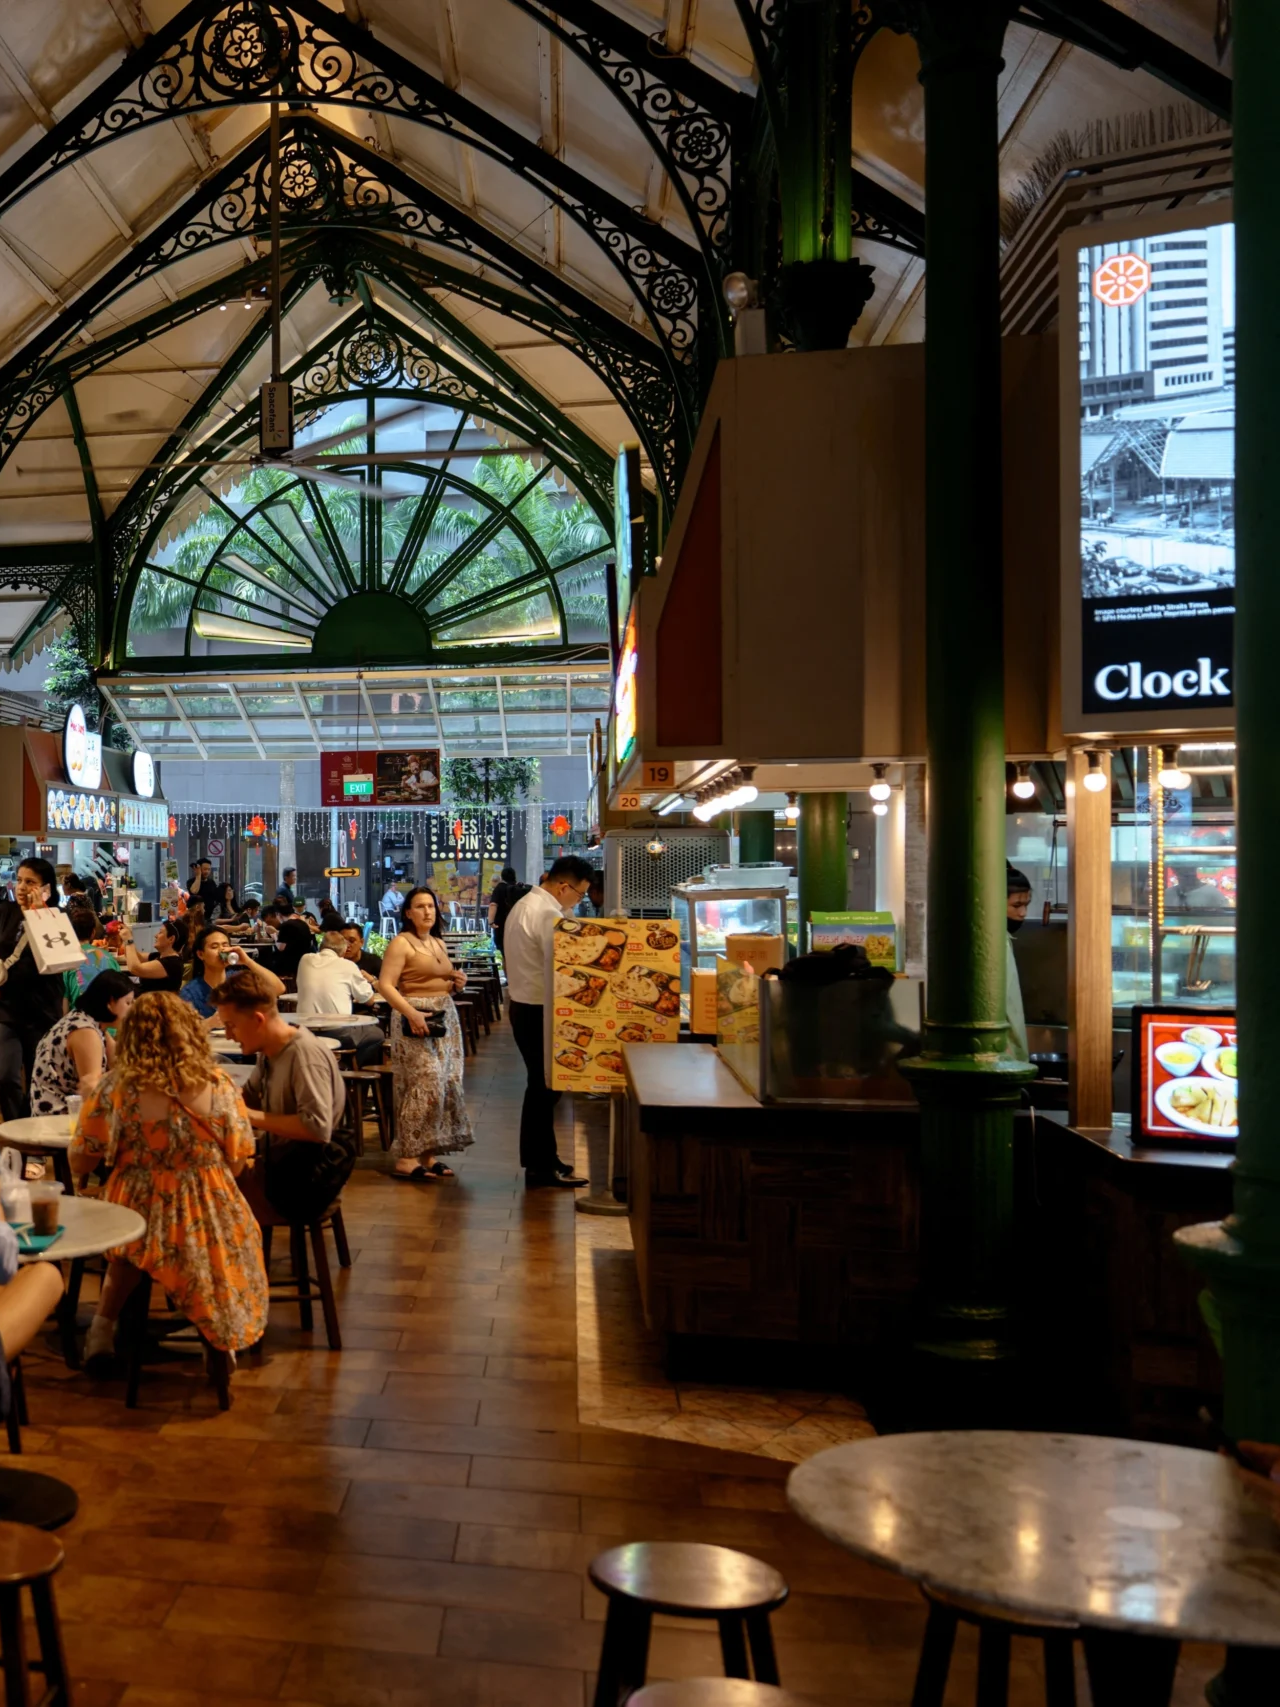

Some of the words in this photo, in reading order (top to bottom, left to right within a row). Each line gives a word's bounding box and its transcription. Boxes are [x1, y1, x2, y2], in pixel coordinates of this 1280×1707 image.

[268, 386, 277, 433] Spacefans
[1094, 657, 1231, 701] Clock
[650, 767, 669, 782] 19
[350, 784, 366, 793] EXIT
[621, 797, 638, 807] 20
[449, 819, 477, 835] PES
